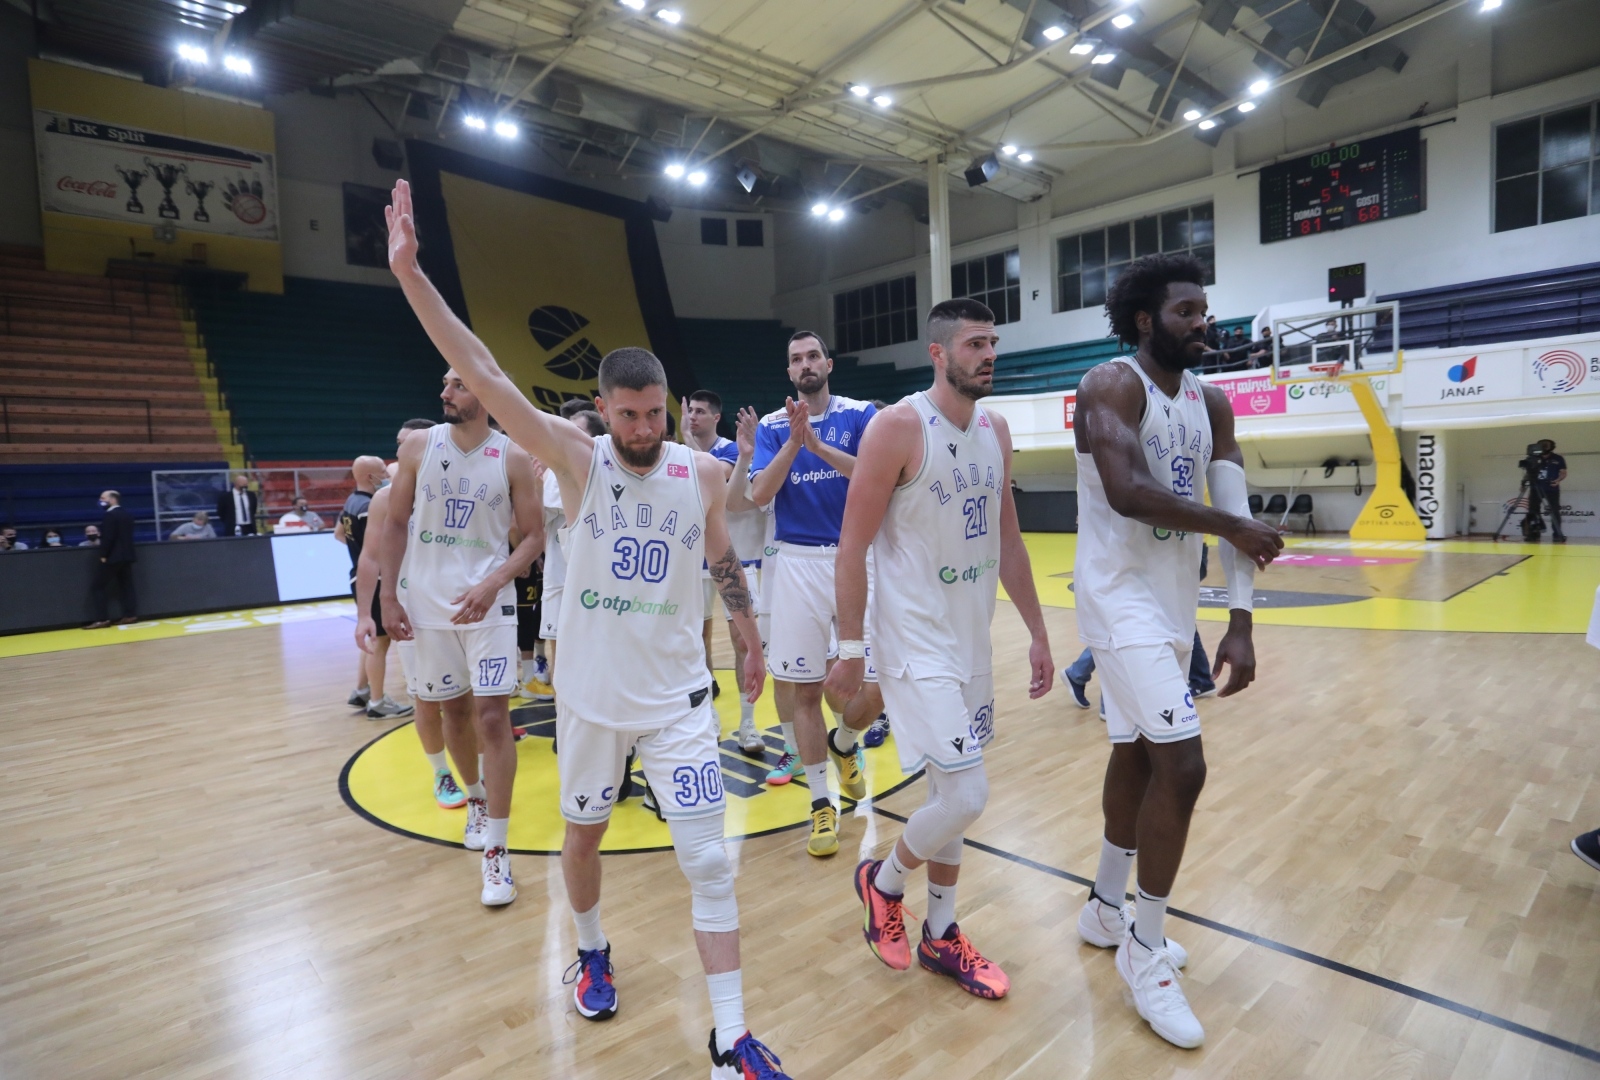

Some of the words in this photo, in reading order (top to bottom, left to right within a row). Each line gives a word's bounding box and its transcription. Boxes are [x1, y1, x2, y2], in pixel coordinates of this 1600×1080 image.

[72, 122, 98, 136] KK
[107, 128, 146, 142] Split
[1331, 169, 1340, 180] 4
[1356, 193, 1380, 208] GOSTI
[1301, 217, 1322, 235] 81
[1032, 289, 1040, 301] F
[1236, 378, 1273, 392] minut
[1440, 385, 1485, 400] JANAF
[771, 421, 790, 431] macro
[1418, 434, 1439, 531] macron
[422, 477, 504, 511] ZADAR
[445, 499, 475, 529] 17
[963, 495, 988, 540] 21
[584, 503, 701, 550] ZADAR
[434, 532, 490, 549] otpbanka
[611, 536, 669, 583] 30
[602, 595, 679, 616] otpbanka
[479, 656, 507, 687] 17
[673, 760, 723, 807] 30
